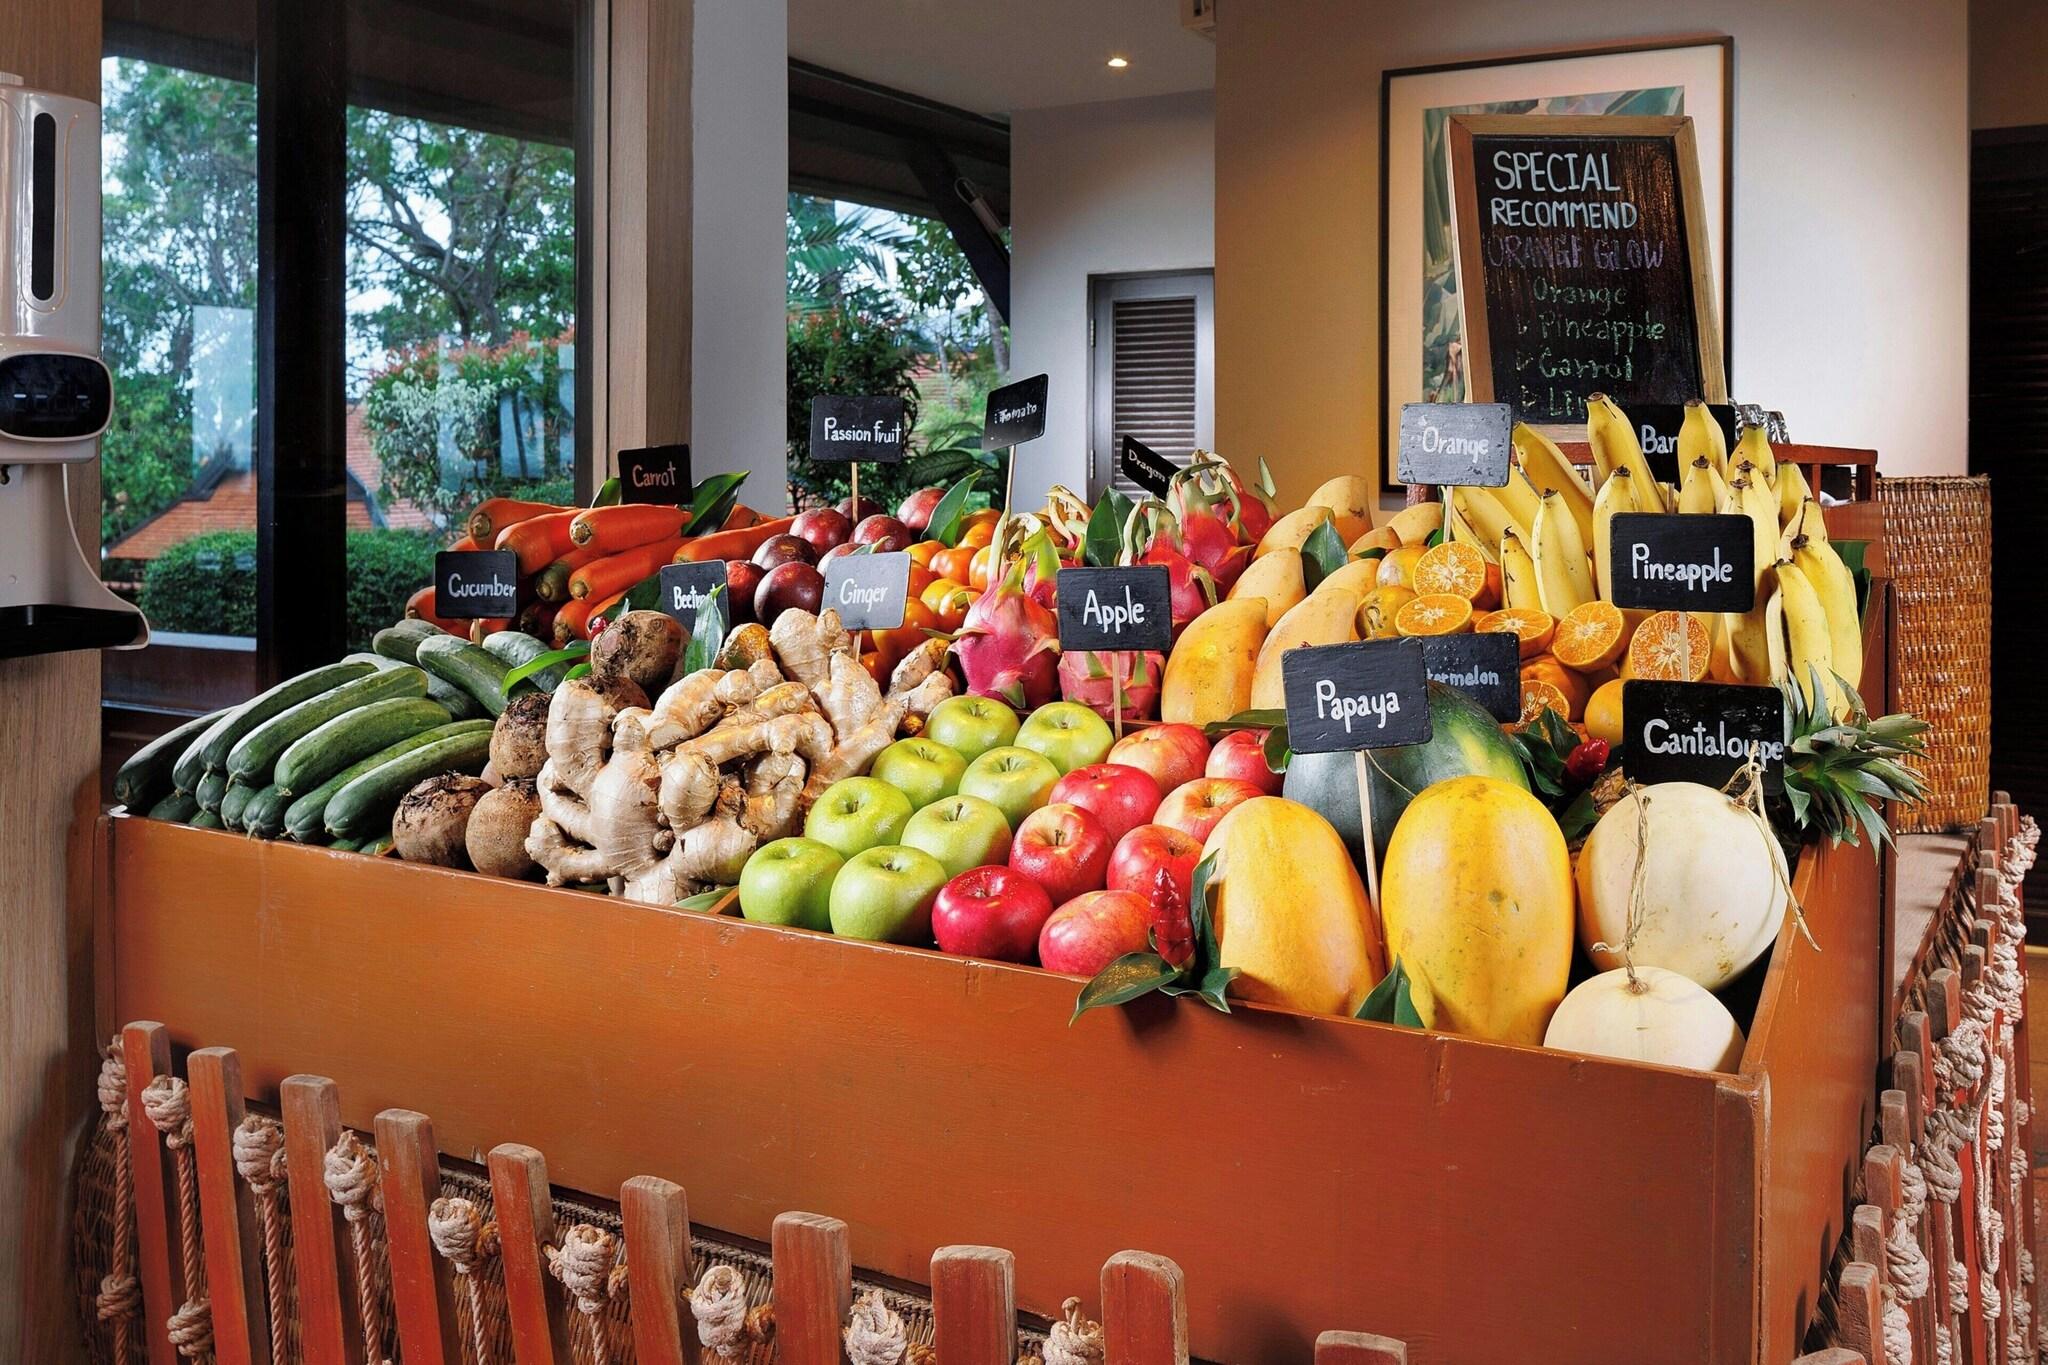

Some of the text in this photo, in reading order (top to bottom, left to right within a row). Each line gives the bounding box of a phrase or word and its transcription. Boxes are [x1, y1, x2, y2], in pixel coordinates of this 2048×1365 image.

[1493, 150, 1621, 193] SPECIAL
[1490, 197, 1638, 229] RECOMMEND
[1533, 276, 1628, 315] Orange
[824, 416, 901, 444] Passion fruit
[1422, 426, 1489, 464] Orange
[632, 461, 677, 488] Carrot
[1128, 448, 1166, 482] Dragon
[448, 573, 517, 598] Cucumber
[1632, 543, 1734, 592] Pineapple
[840, 578, 888, 613] Ginger
[1083, 585, 1146, 634] Apple
[1316, 680, 1401, 734] Papaya
